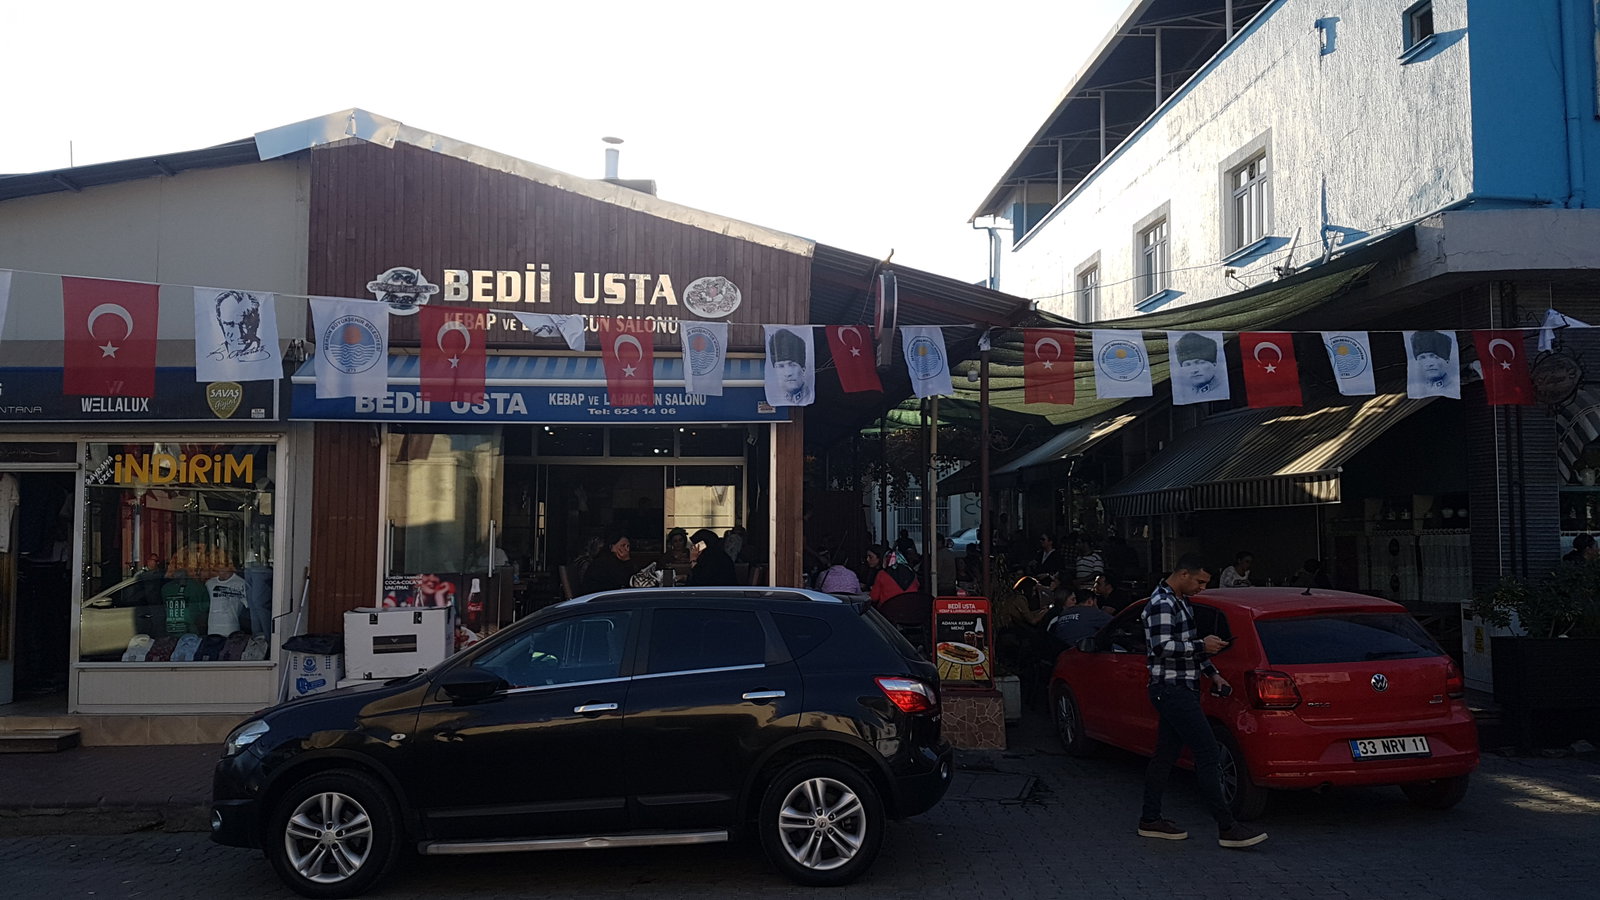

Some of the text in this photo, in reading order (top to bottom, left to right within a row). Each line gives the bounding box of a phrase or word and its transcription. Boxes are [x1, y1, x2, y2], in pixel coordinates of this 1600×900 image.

[574, 271, 678, 306] USTA
[444, 312, 497, 331] KEBAP
[502, 318, 517, 331] VE
[615, 314, 678, 334] SALONU
[81, 397, 149, 412] WELLALUX
[450, 392, 528, 415] USTA
[549, 393, 585, 406] KEBAP
[665, 393, 707, 406] SALONU
[1359, 740, 1377, 754] 33
[1382, 739, 1406, 753] NRV
[1413, 737, 1426, 751] 11
